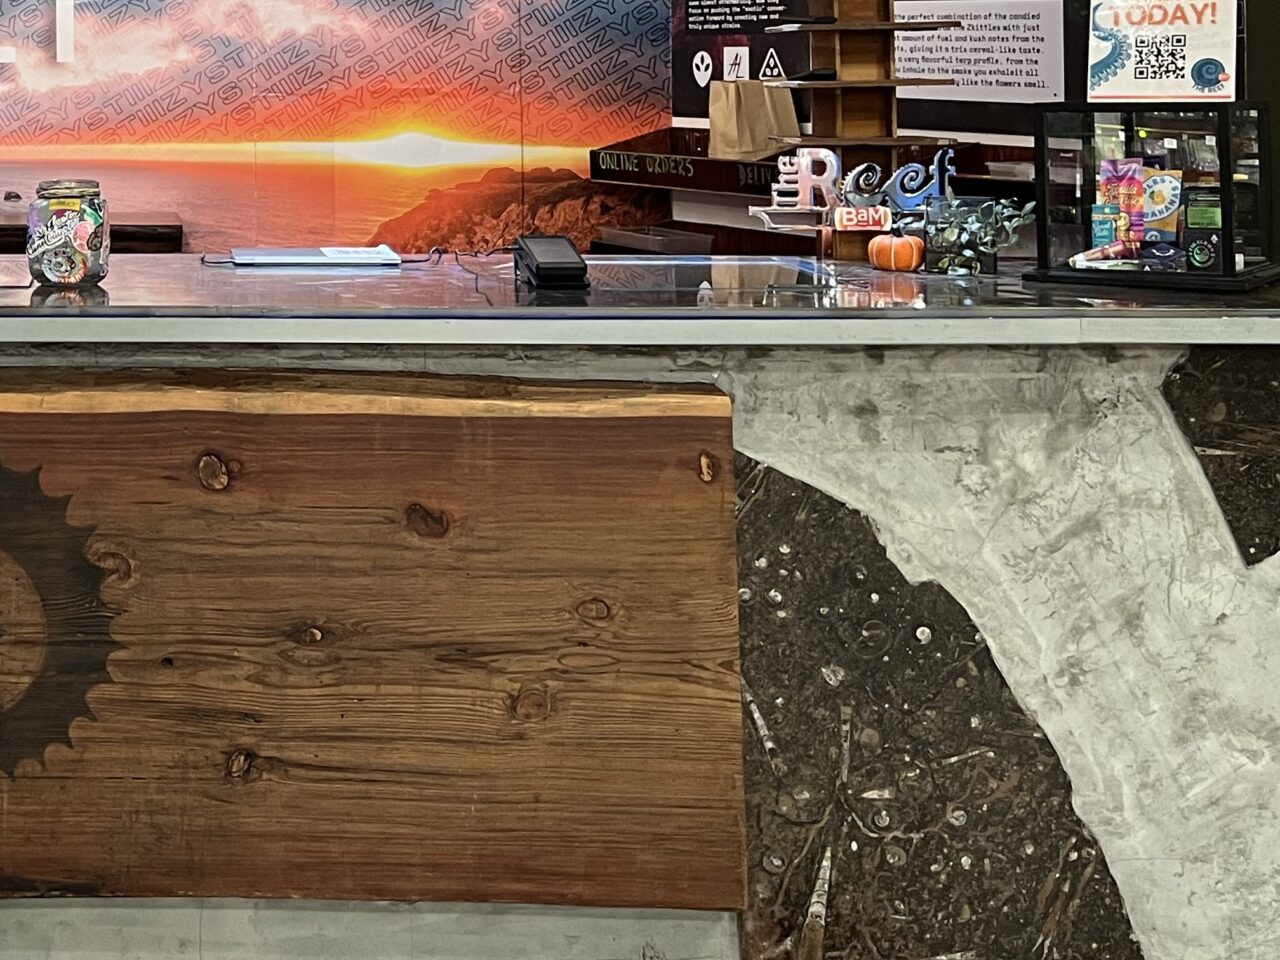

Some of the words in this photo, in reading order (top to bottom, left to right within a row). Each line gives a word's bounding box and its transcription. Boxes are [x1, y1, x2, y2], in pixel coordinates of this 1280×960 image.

[907, 13, 934, 22] perfect
[937, 12, 982, 20] combination
[1009, 12, 1041, 20] candied
[1108, 2, 1218, 27] TODAY!
[1023, 24, 1040, 33] just
[909, 45, 933, 54] giving
[969, 45, 1016, 54] cereal-like
[955, 57, 972, 65] terp
[1006, 57, 1023, 65] from
[903, 66, 925, 74] inhale
[951, 67, 972, 75] smoke
[973, 69, 987, 77] you
[961, 78, 978, 86] like
[599, 152, 640, 171] ONLINE
[646, 155, 694, 177] ORDERS
[796, 147, 956, 211] Reef
